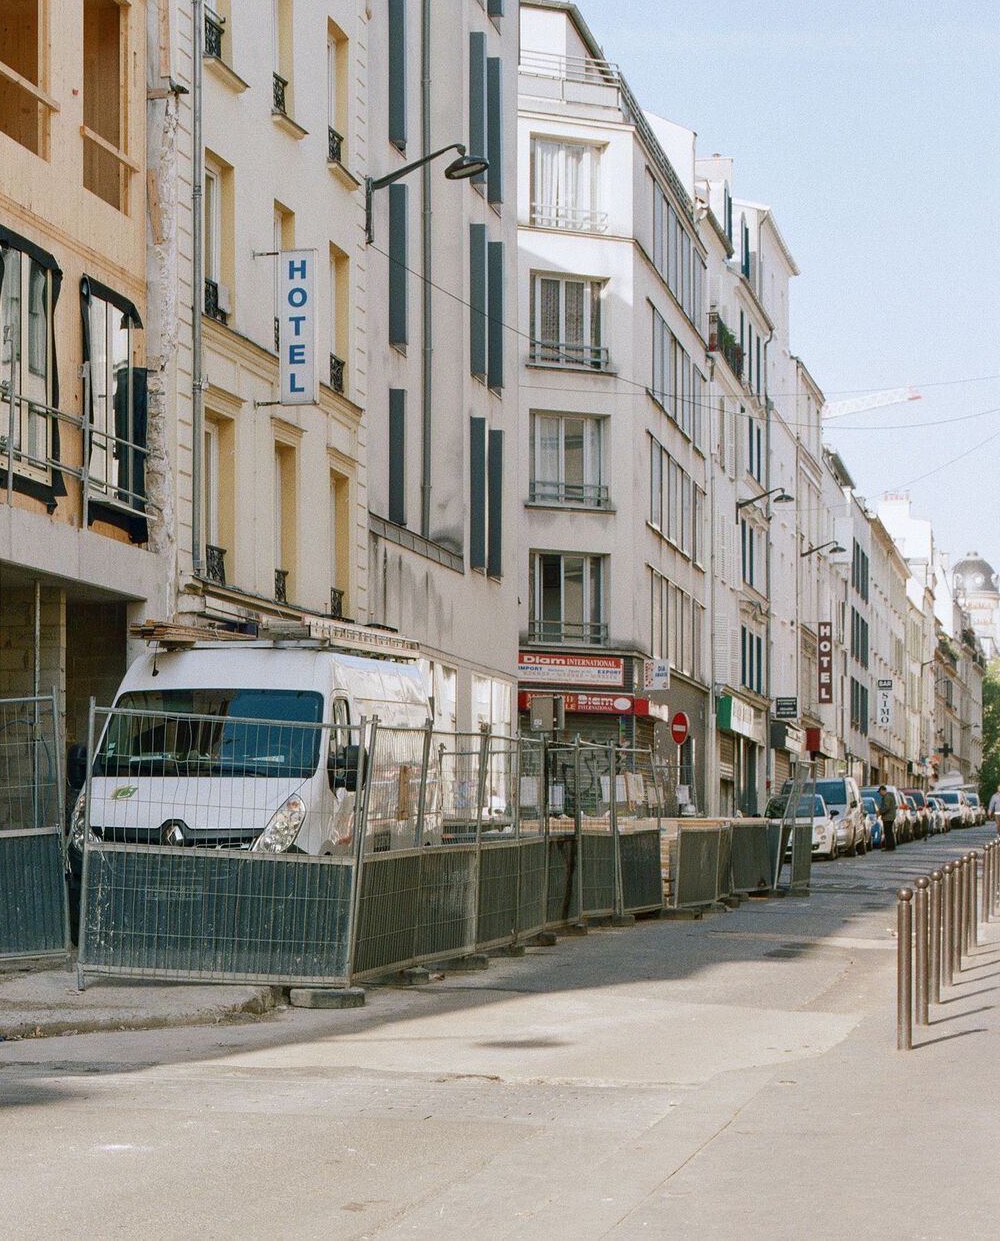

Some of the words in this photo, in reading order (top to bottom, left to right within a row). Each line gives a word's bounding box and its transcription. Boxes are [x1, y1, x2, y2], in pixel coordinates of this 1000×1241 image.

[287, 260, 308, 393] HOTEL
[566, 658, 617, 668] INTERNATIONAL
[820, 625, 831, 699] HOTEL
[881, 692, 890, 724] SIMO
